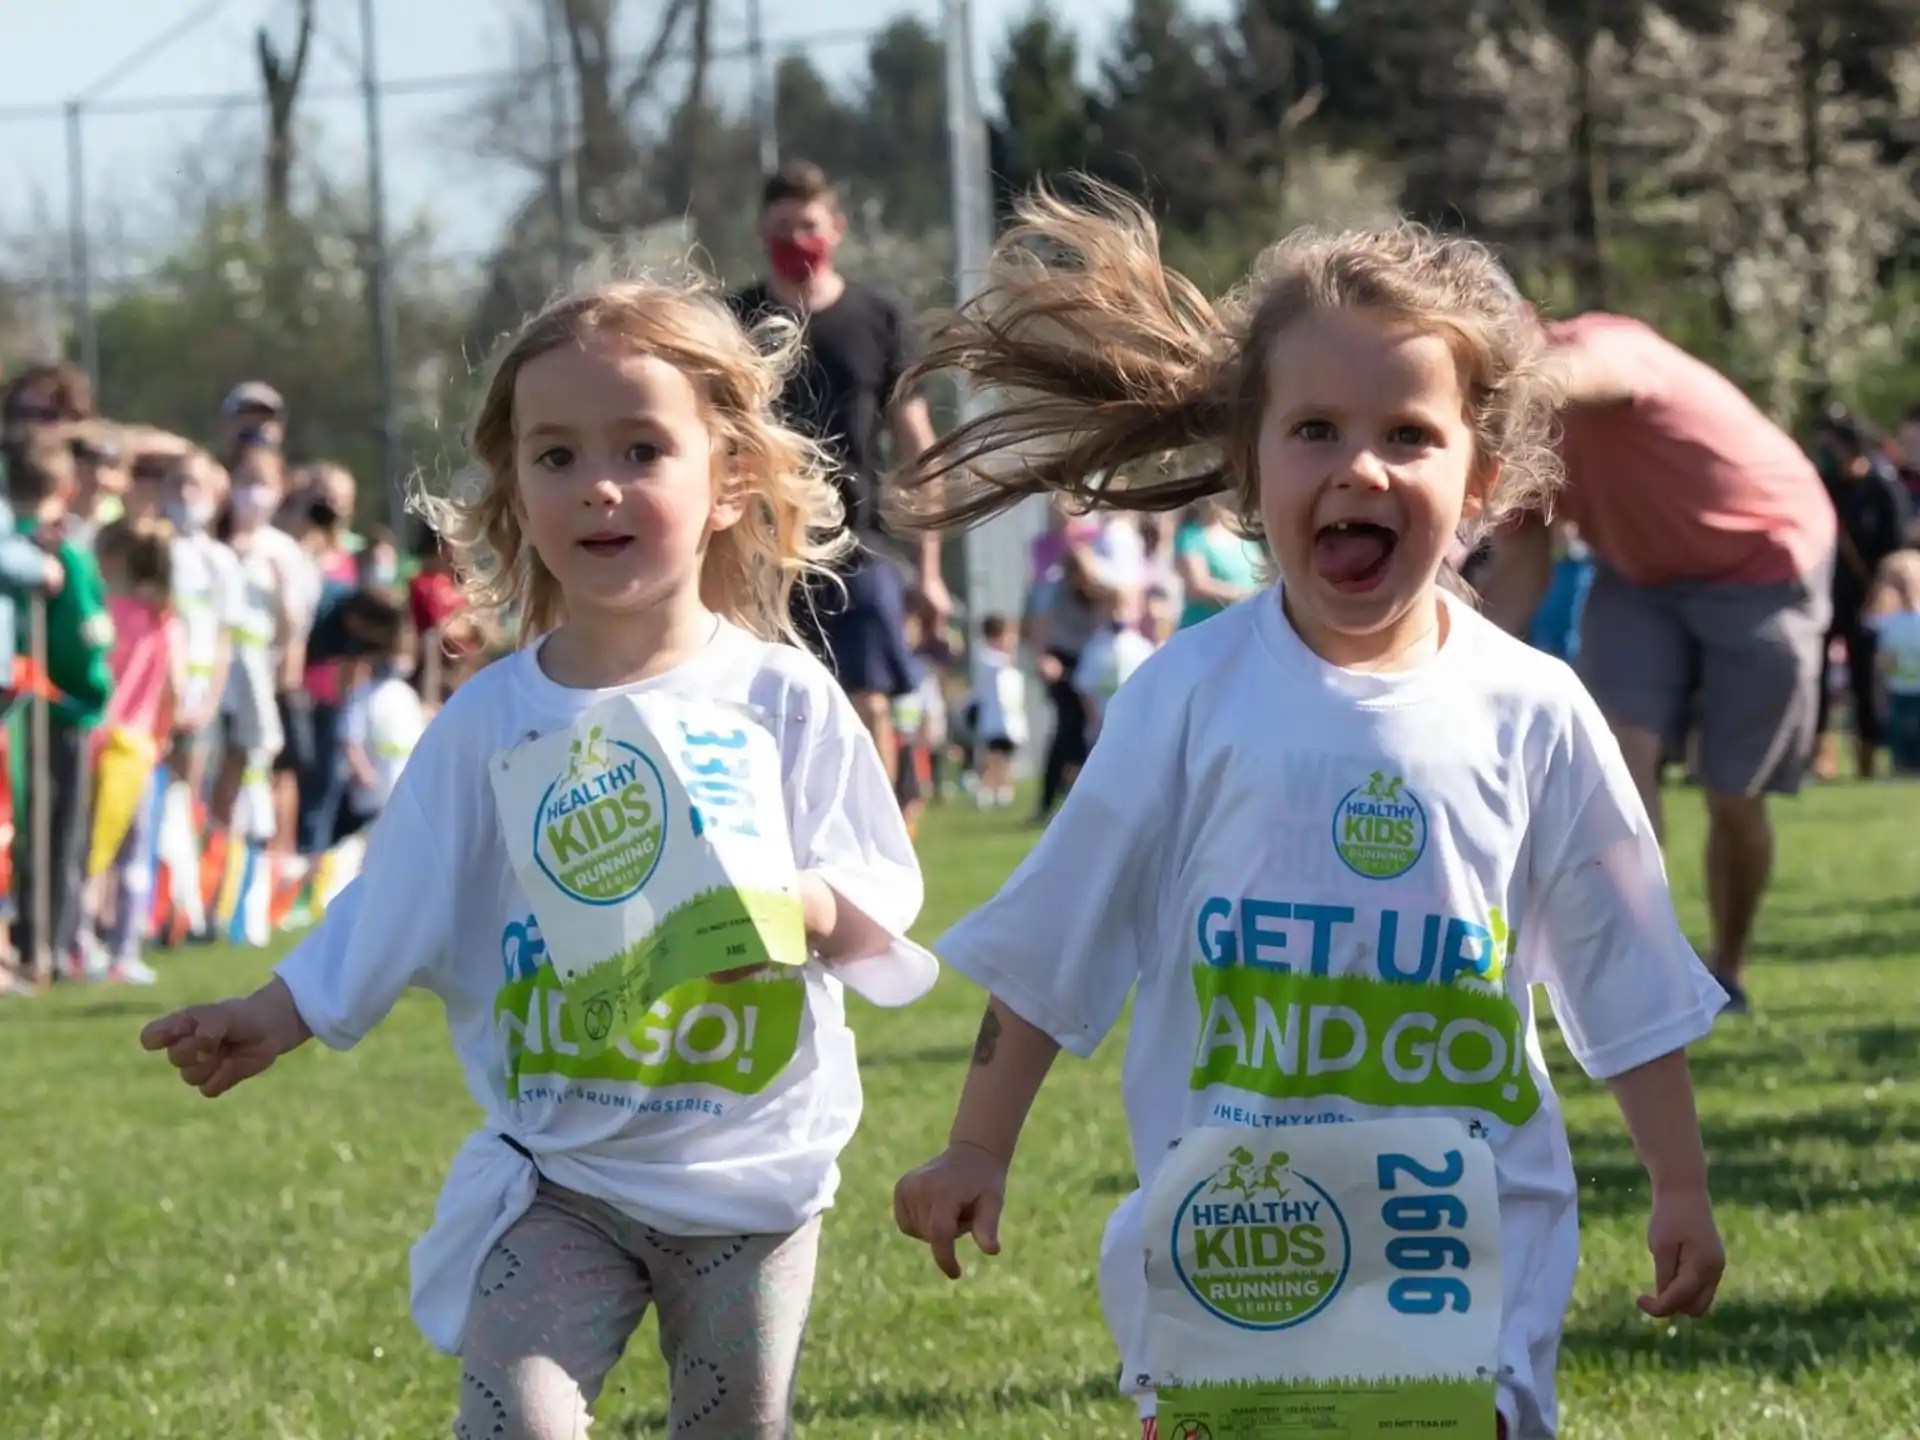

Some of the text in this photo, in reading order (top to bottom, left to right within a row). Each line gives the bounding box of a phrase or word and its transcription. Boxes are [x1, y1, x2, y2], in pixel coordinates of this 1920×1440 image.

[547, 759, 637, 824] HEALTHY
[1346, 801, 1416, 819] HEALTHY
[547, 783, 652, 865] KIDS
[1344, 814, 1415, 847] KIDS
[575, 837, 655, 890] RUNNING
[1197, 896, 1494, 985] GET UP
[615, 1000, 759, 1075] GO!
[1195, 994, 1523, 1102] AND GO!
[1192, 1200, 1321, 1226] HEALTHY
[1376, 1148, 1472, 1316] 2666
[1193, 1223, 1326, 1270] KIDS
[1209, 1280, 1320, 1301] RUNNING
[1236, 1301, 1293, 1315] SERIES
